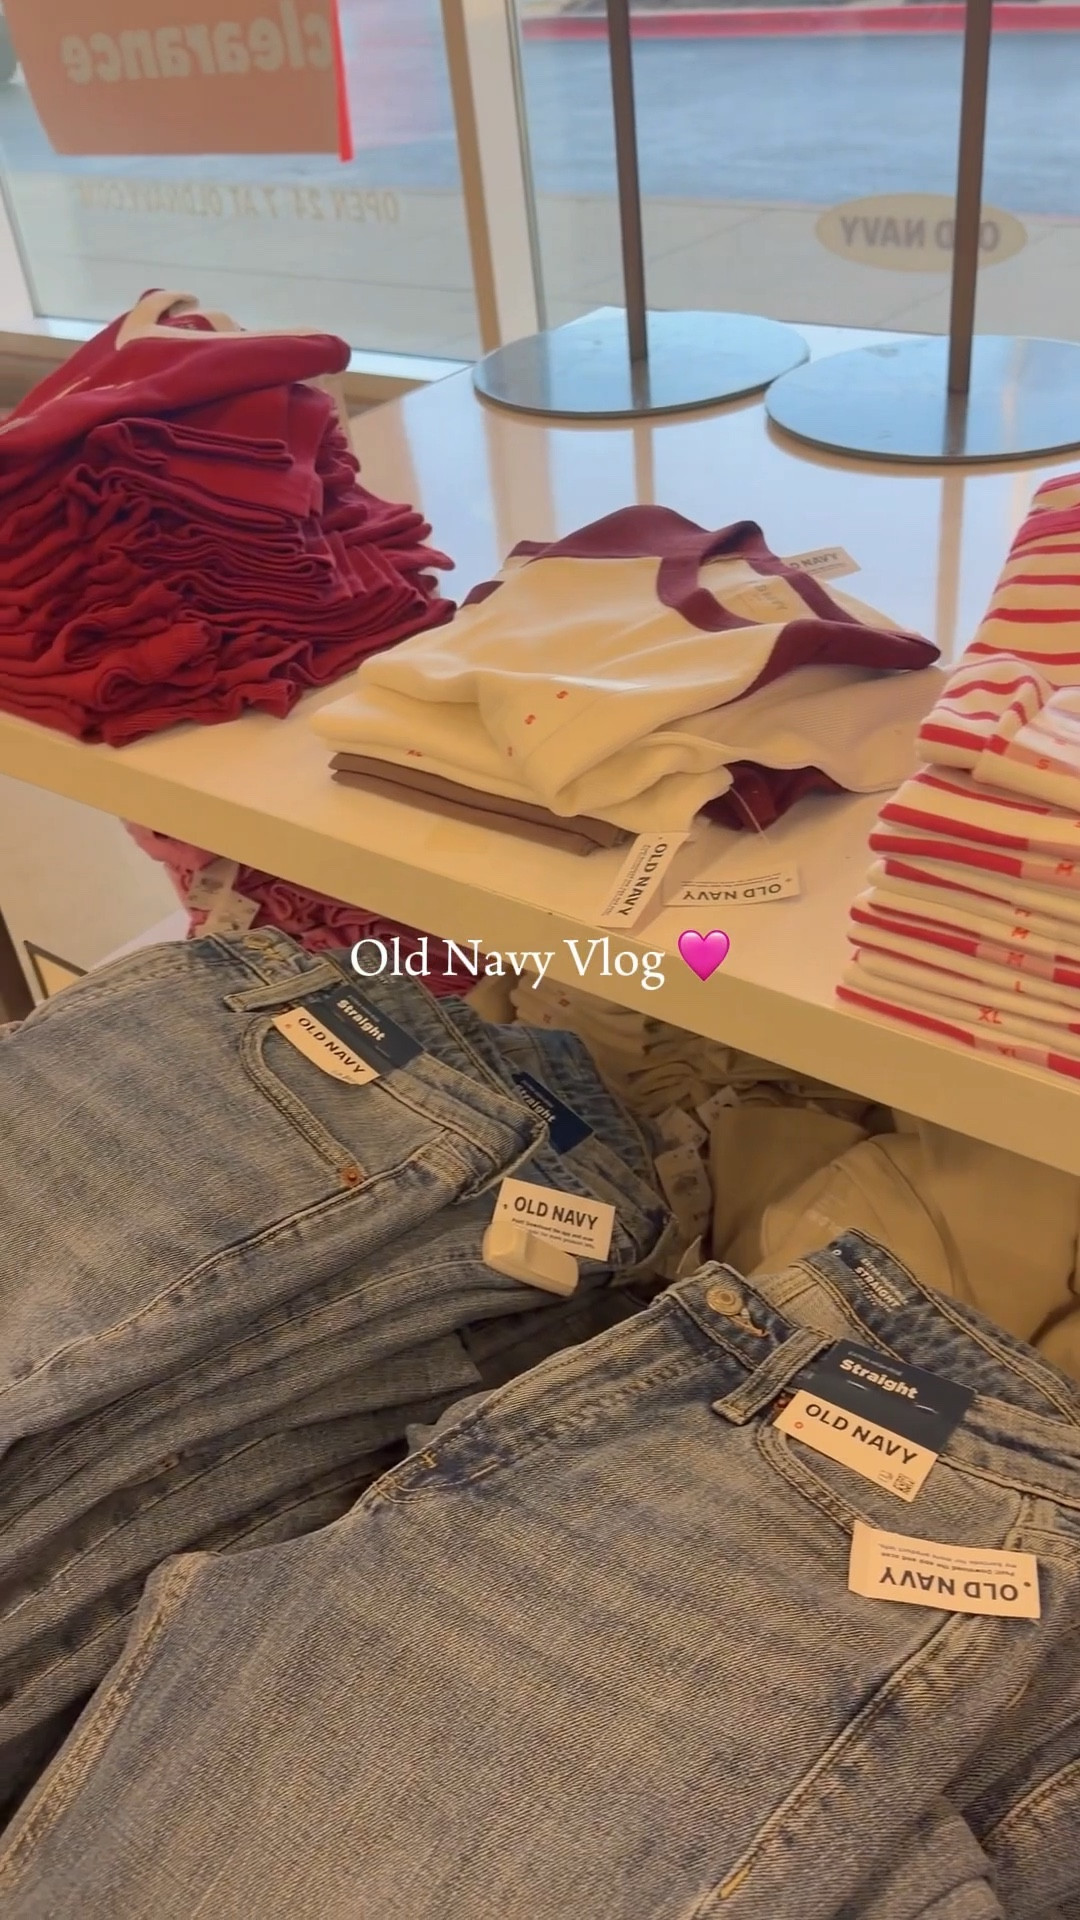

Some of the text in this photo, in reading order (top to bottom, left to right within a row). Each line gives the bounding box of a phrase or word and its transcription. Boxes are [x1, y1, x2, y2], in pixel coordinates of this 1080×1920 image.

[801, 552, 839, 567] NAVY
[644, 843, 668, 874] OLD
[618, 876, 651, 916] NAVY
[682, 883, 782, 901] OLD NAVY
[337, 999, 386, 1042] Straight
[298, 1017, 366, 1074] OLD NAVY
[514, 1196, 549, 1218] OLD
[551, 1205, 598, 1230] NAVY
[855, 1266, 900, 1308] STRAIGHT
[839, 1358, 918, 1399] Straight
[805, 1403, 918, 1465] OLD NAVY
[879, 1566, 1018, 1601] OLD NAVY
